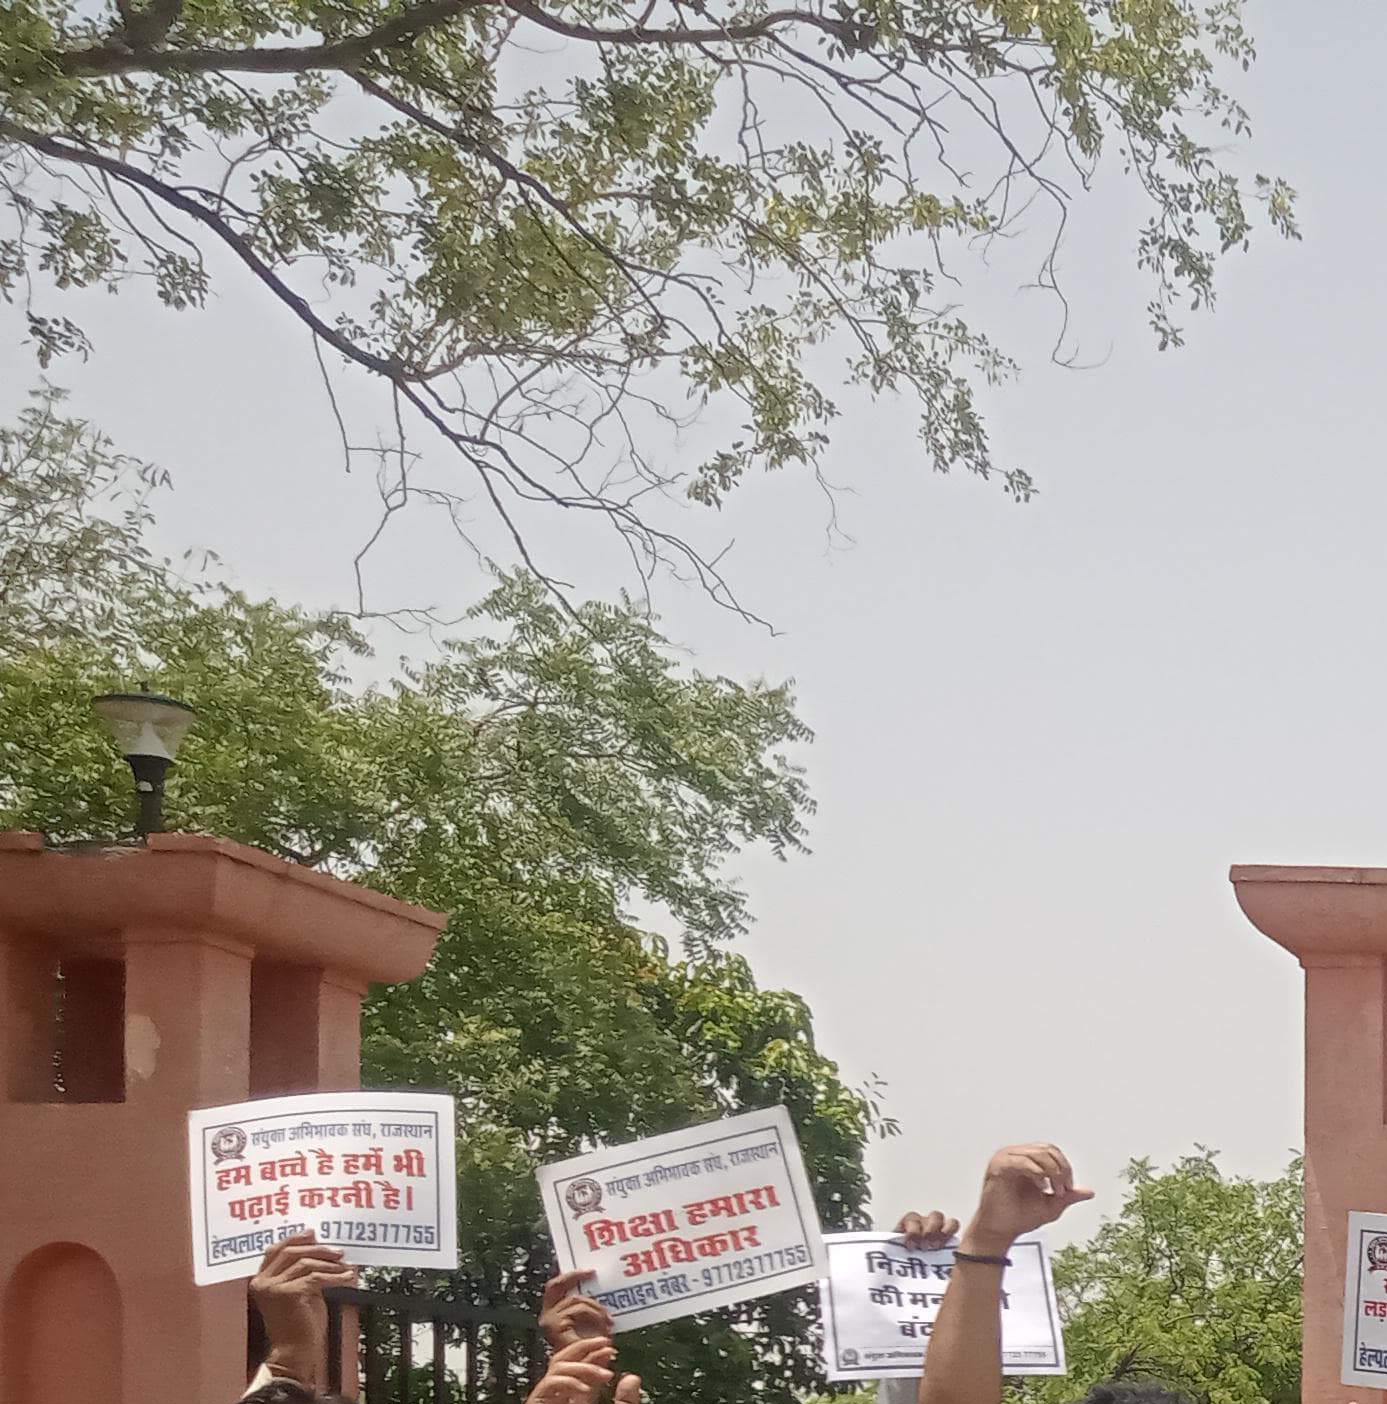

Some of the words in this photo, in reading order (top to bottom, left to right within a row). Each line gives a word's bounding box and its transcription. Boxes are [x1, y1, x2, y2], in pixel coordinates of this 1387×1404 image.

[215, 1164, 252, 1191] हम
[258, 1150, 308, 1181] बच्चे
[307, 1148, 333, 1175] है
[393, 1148, 426, 1177] भी
[225, 1184, 289, 1224] पढ़ाई
[297, 1180, 375, 1209] करनी
[582, 1209, 679, 1251] शिक्षा
[681, 1185, 780, 1225] हमारा
[319, 1220, 434, 1251] 9772377755
[619, 1225, 761, 1277] अधिकार
[700, 1244, 806, 1287] 9772377755
[865, 1249, 929, 1279] निजी
[868, 1284, 903, 1307] की
